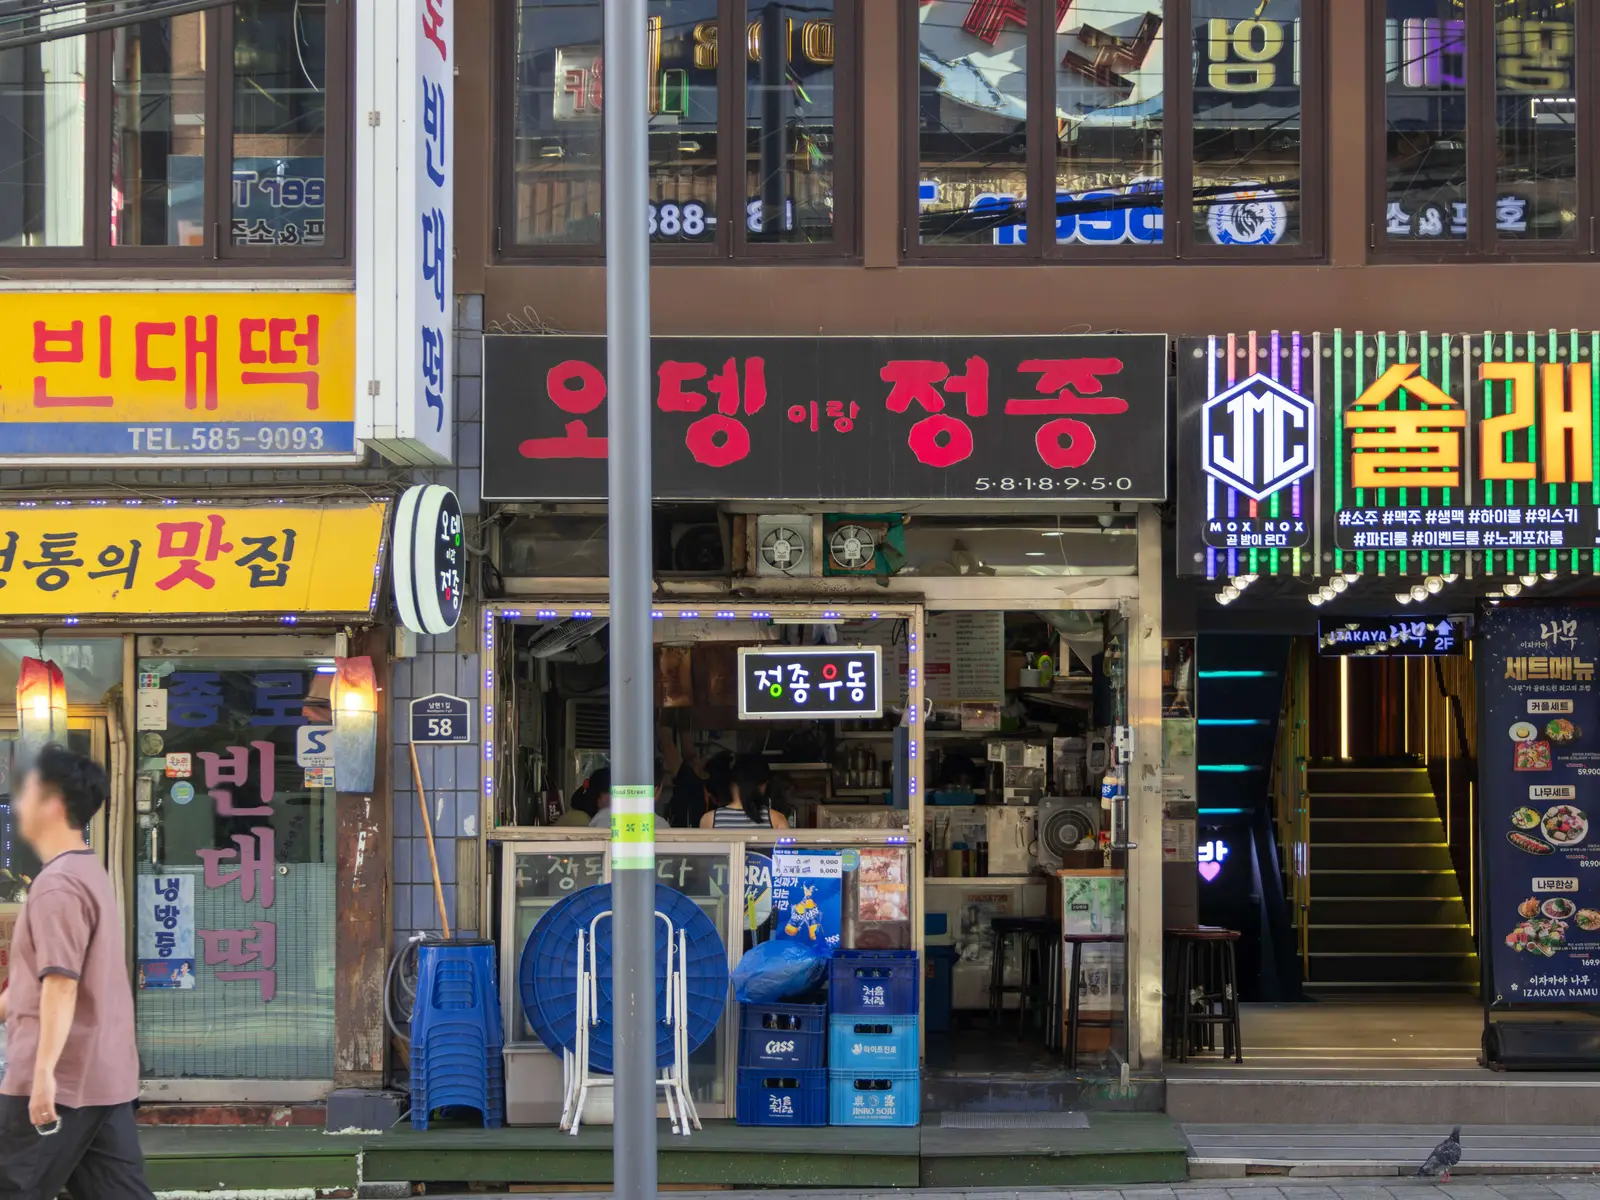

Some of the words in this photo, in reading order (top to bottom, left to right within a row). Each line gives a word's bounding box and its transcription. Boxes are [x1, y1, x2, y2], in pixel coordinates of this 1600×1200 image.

[422, 75, 445, 433] 빈대떡
[33, 314, 320, 411] 빈대떡
[518, 355, 767, 468] 오뎅
[787, 400, 860, 433] 이랑
[879, 355, 1130, 469] 정종
[1344, 361, 1593, 488] 술래
[127, 427, 324, 451] TEL.585-9093
[1213, 390, 1304, 486] JMC
[441, 510, 460, 547] 오뎅
[1209, 521, 1251, 532] MOX
[1264, 521, 1304, 532] NOX
[1338, 510, 1378, 526] #소주
[1382, 510, 1422, 525] #맥주
[1425, 509, 1465, 525] #생맥
[1468, 508, 1522, 524] #하이볼
[1525, 508, 1578, 524] #위스키
[1226, 534, 1238, 546] 곧
[1240, 534, 1262, 546] 밤이
[1264, 534, 1287, 546] 온다
[1353, 531, 1408, 547] #파티룸
[1411, 530, 1480, 547] #이벤트룸
[1483, 529, 1563, 546] #노래포차룸
[440, 569, 460, 610] 정종
[1329, 630, 1387, 641] IZAKAYA
[1389, 621, 1427, 648] 나무
[1434, 637, 1454, 650] 2F
[1540, 620, 1578, 650] 나무
[1504, 656, 1595, 681] 세트메뉴
[166, 672, 309, 728] 종로
[1531, 701, 1569, 711] 커플세트
[428, 718, 453, 737] 58
[1534, 787, 1571, 797] 나무세트
[196, 741, 277, 1002] 빈대떡
[1580, 860, 1600, 868] 89,90
[1537, 879, 1574, 890] 나무한상
[154, 878, 181, 958] 냉방중
[1529, 974, 1568, 986] 이자카야
[1571, 974, 1590, 986] 나무
[1523, 989, 1565, 997] IZAKAYA
[1569, 988, 1598, 997] NAMU
[852, 1107, 875, 1116] JINRO
[876, 1107, 896, 1116] SOJU
